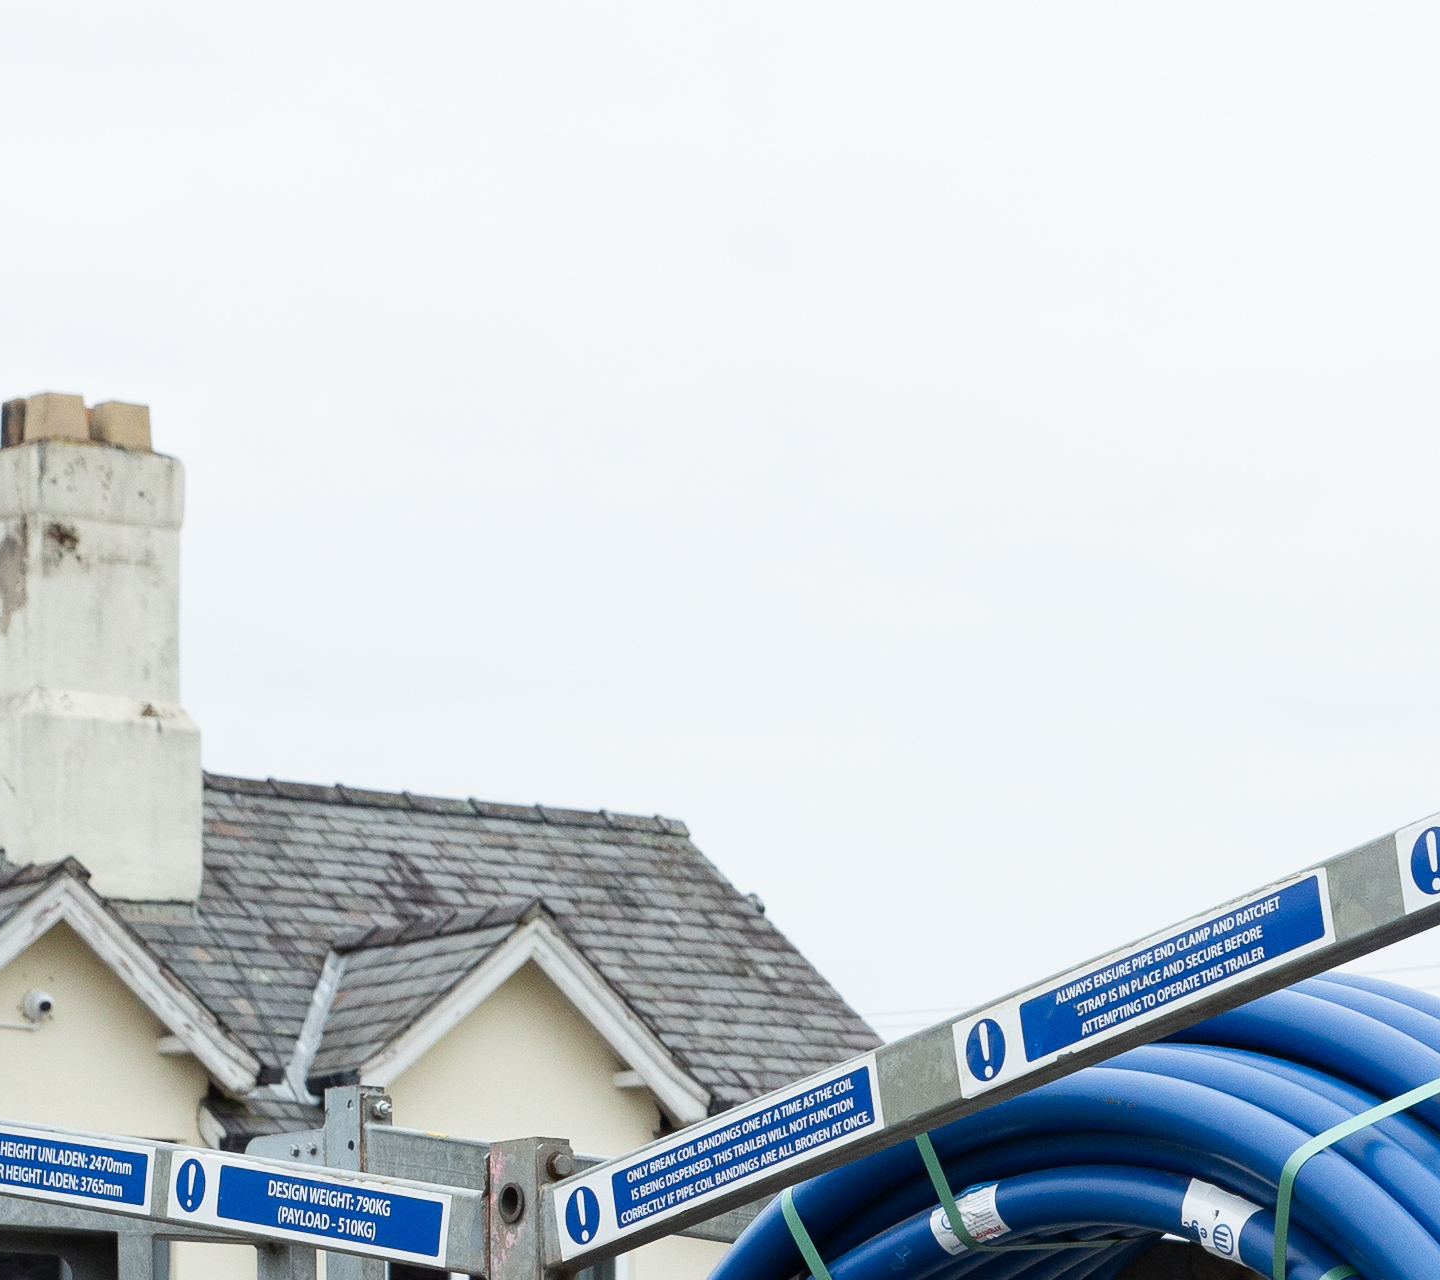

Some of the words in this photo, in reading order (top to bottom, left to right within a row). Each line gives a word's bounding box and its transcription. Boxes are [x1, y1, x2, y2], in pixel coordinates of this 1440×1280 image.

[1056, 977, 1092, 1005] ALWAYS
[1094, 961, 1130, 988] ENSURE
[1132, 951, 1153, 972] PIPE
[1155, 942, 1174, 963] END
[1176, 926, 1210, 953] CLAMP
[1213, 916, 1234, 938] AND
[1236, 897, 1280, 928] RATCHET
[1077, 991, 1107, 1016] STRAP
[1110, 987, 1116, 1003] IS
[1119, 982, 1129, 998] IN
[1131, 969, 1161, 993] PLACE
[1163, 959, 1184, 980] AND
[1186, 942, 1223, 970] SECURE
[1225, 926, 1263, 954] BEFORE
[1081, 997, 1141, 1035] ATTEMPTING
[1143, 992, 1155, 1009] TO
[1157, 973, 1199, 1003] OPERATE
[1201, 964, 1223, 985] THIS
[1225, 947, 1264, 975] TRAILER
[1, 1141, 36, 1160] HEIGHT
[38, 1147, 87, 1168] UNLADEN:
[89, 1155, 132, 1175] 2470mm
[621, 1194, 666, 1224] CORRECTLY
[668, 1190, 674, 1204] IF
[676, 1183, 694, 1201] PIPE
[696, 1174, 714, 1193] COIL
[716, 1156, 759, 1185] BANDINGS
[761, 1148, 777, 1166] ARE
[779, 1141, 794, 1159] ALL
[796, 1127, 829, 1152] BROKEN
[831, 1122, 842, 1138] AT
[844, 1110, 870, 1132] ONCE.
[627, 1163, 648, 1183] ONLY
[650, 1151, 676, 1173] BREAK
[678, 1143, 697, 1162] COIL
[698, 1124, 740, 1154] BANDINGS
[742, 1116, 760, 1135] ONE
[762, 1111, 773, 1127] AT
[774, 1108, 780, 1123] A
[782, 1099, 802, 1119] TIME
[803, 1094, 814, 1110] AS
[815, 1087, 832, 1105] THE
[833, 1078, 854, 1098] COIL
[631, 1187, 638, 1200] IS
[640, 1176, 664, 1197] BEING
[666, 1156, 713, 1186] DISPENSED.
[713, 1148, 732, 1167] THIS
[733, 1133, 767, 1158] TRAILER
[768, 1124, 788, 1144] WILL
[790, 1117, 807, 1135] NOT
[809, 1097, 853, 1127] FUNCTION
[6, 1165, 42, 1185] HEIGHT
[43, 1171, 78, 1191] LADEN:
[81, 1177, 122, 1197] 3765mm
[268, 1180, 307, 1202] DESIGN
[310, 1187, 354, 1210] WEIGHT:
[356, 1195, 391, 1216] 790KG
[278, 1206, 329, 1232] (PAYLOAD
[338, 1216, 376, 1240] 510KG)
